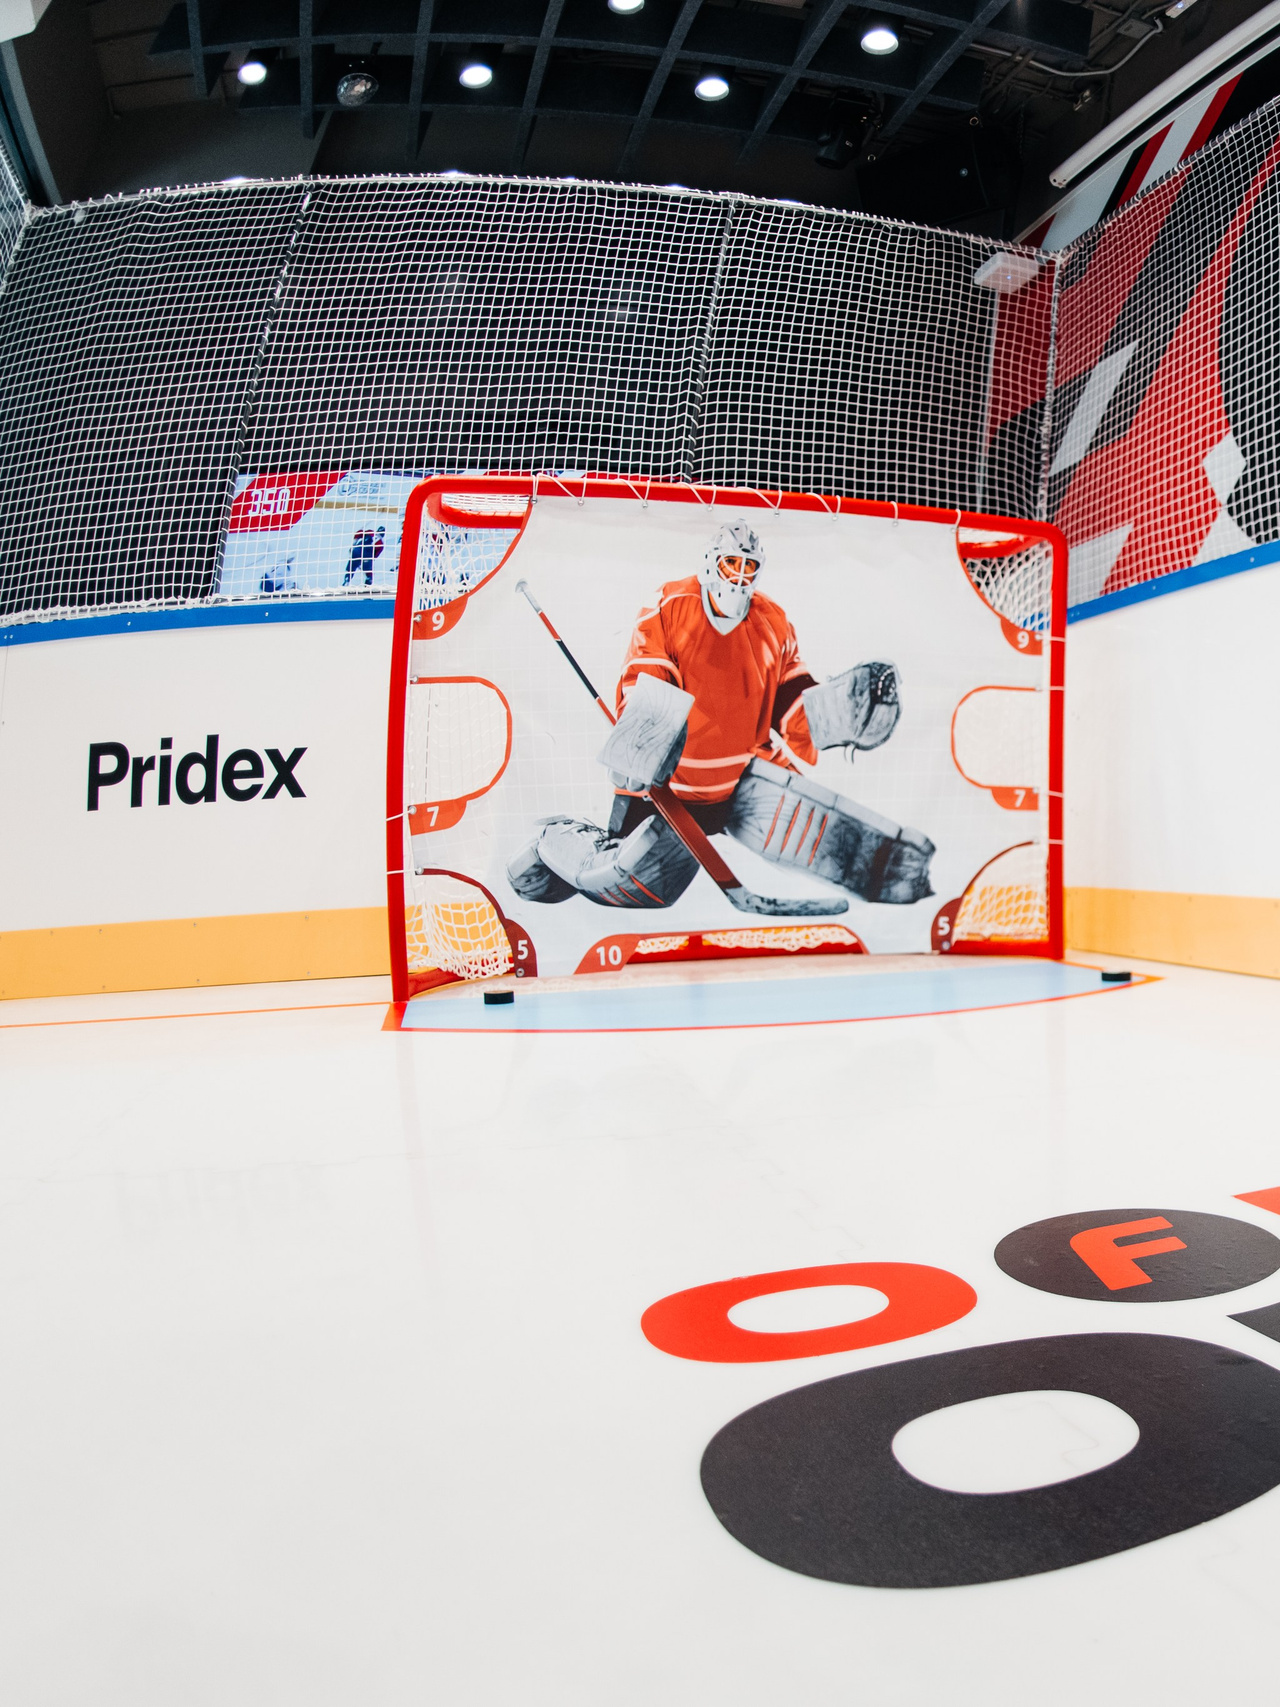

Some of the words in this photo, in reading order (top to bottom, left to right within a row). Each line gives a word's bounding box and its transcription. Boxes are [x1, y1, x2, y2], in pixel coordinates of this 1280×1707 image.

[248, 488, 291, 516] 350
[432, 611, 445, 631] 9
[1017, 631, 1030, 649] 9
[87, 734, 308, 812] Pridex
[1013, 789, 1026, 808] 7
[426, 805, 440, 827] 7
[937, 915, 951, 936] 5
[517, 939, 529, 961] 5
[596, 945, 622, 966] 10
